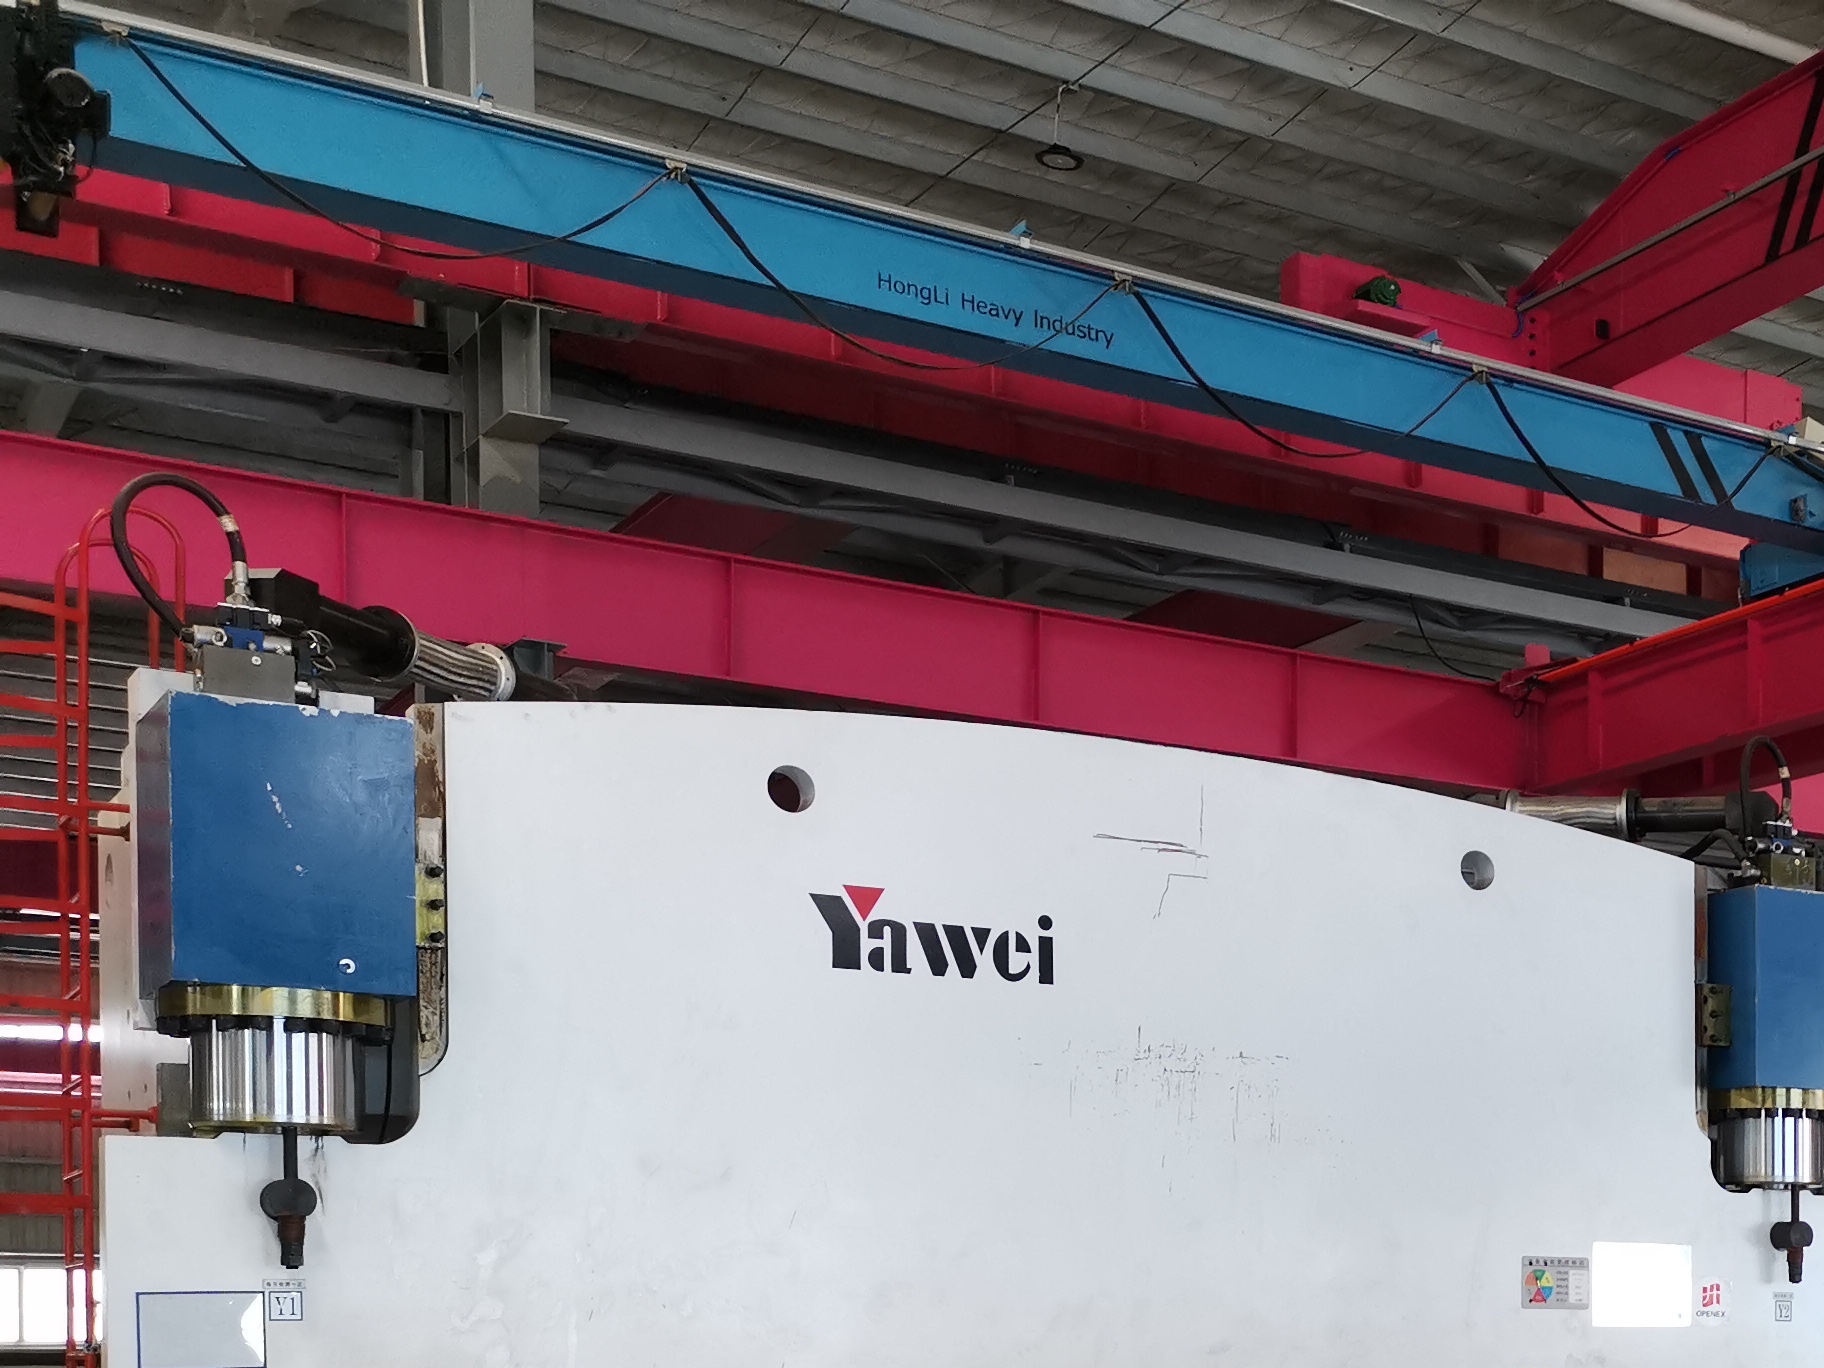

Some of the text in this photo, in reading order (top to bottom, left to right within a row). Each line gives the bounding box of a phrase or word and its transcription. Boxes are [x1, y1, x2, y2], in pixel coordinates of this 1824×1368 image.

[877, 271, 1115, 349] HongLi Heavy Industry
[808, 884, 1055, 987] Yawei
[274, 1296, 298, 1316] Y1
[1696, 1310, 1726, 1318] OPENEX
[1777, 1303, 1790, 1319] Y2
